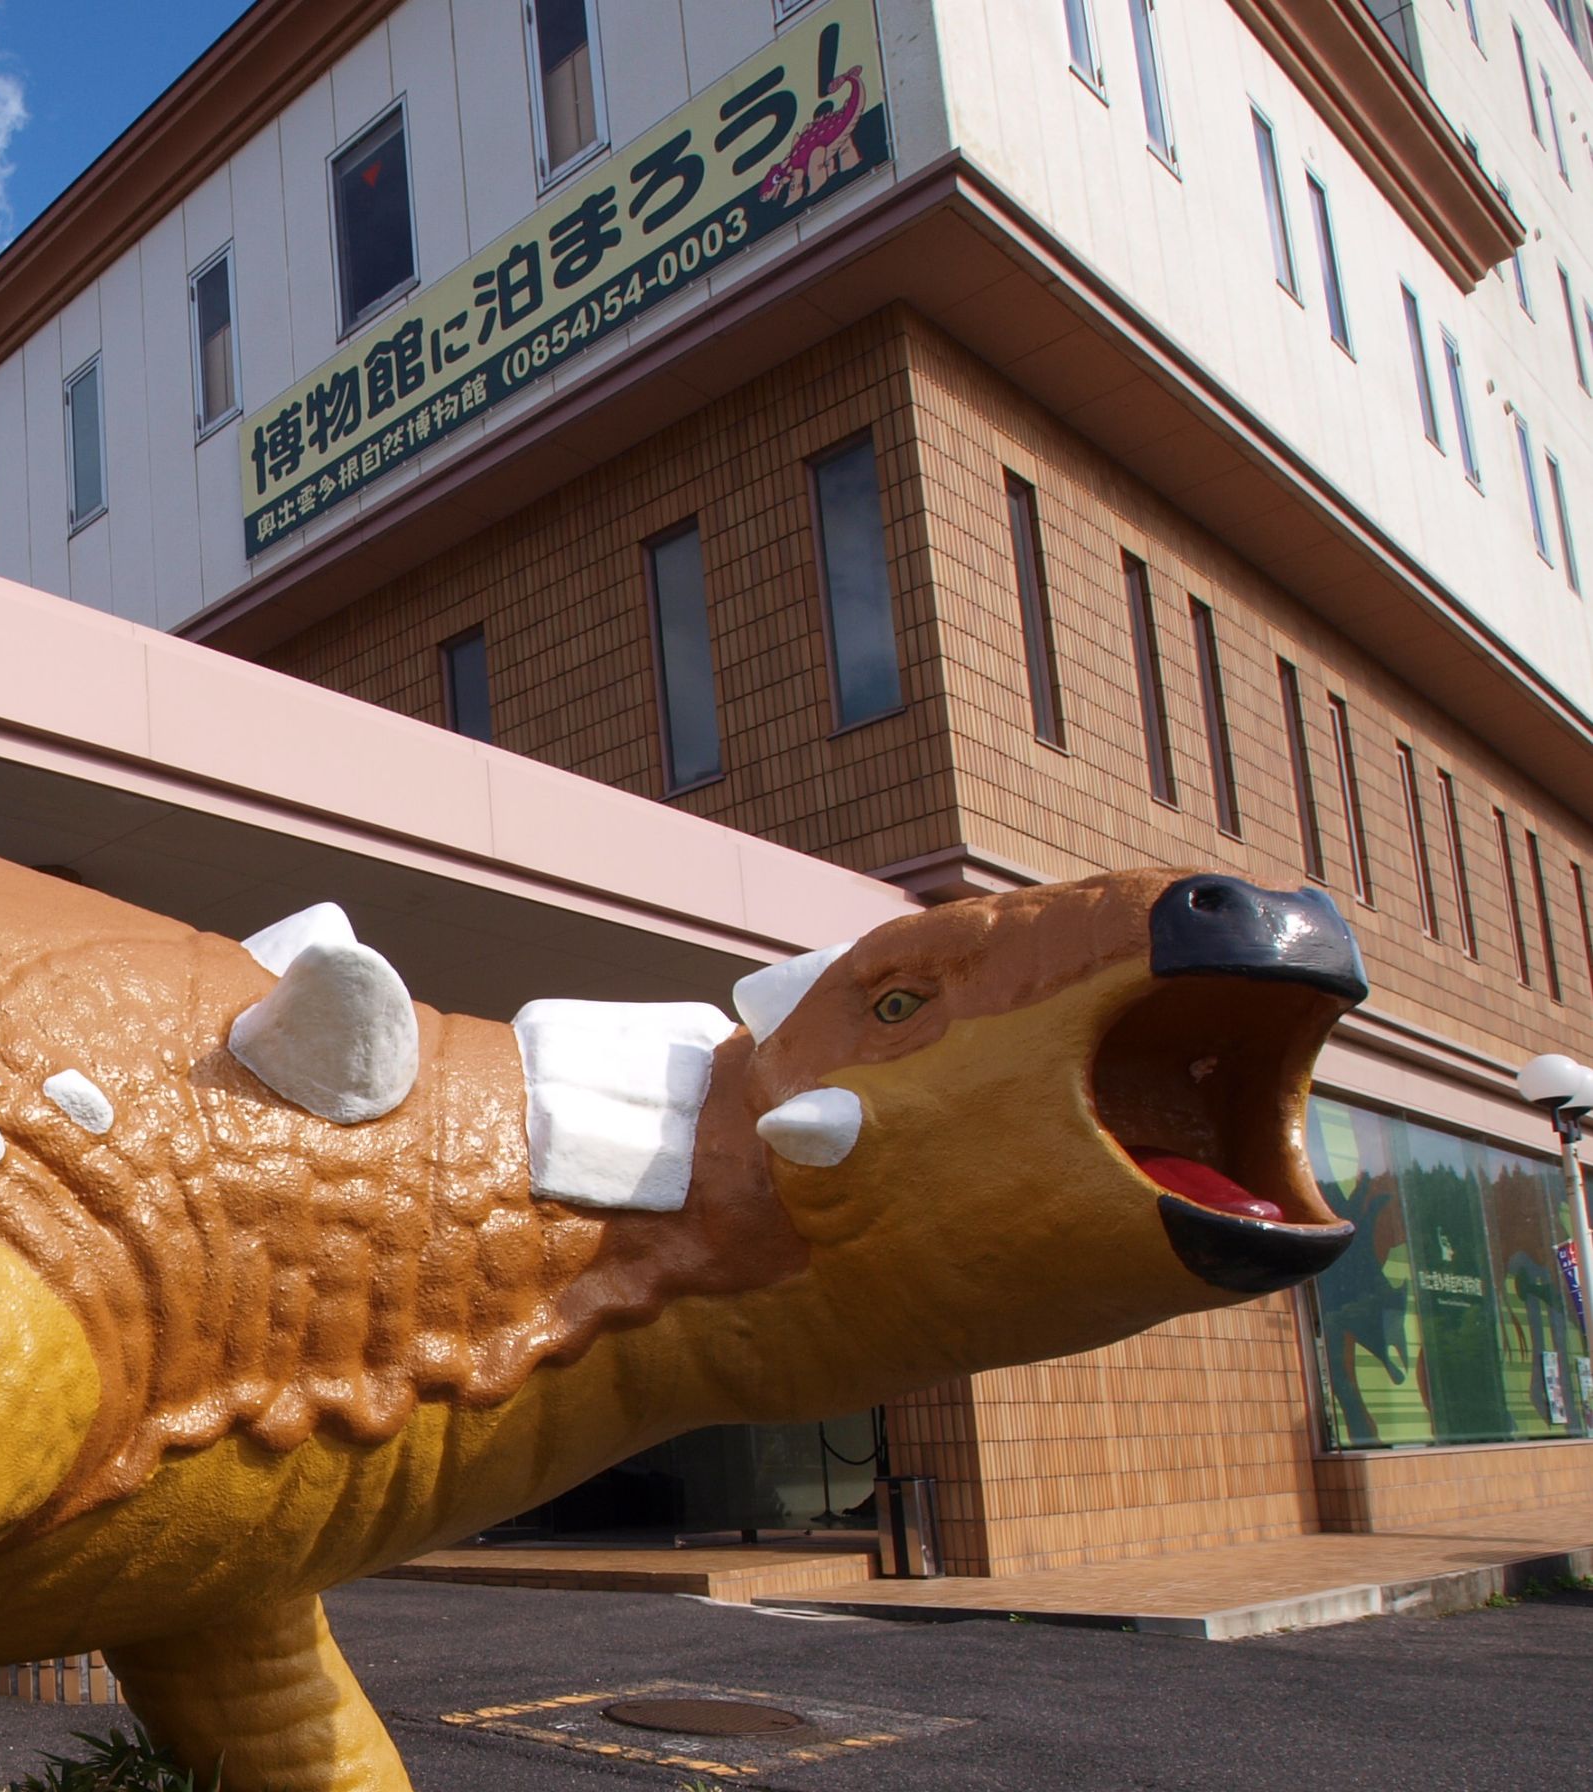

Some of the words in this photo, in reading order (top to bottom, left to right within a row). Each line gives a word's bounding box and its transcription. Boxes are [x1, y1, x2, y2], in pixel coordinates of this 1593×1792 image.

[256, 372, 488, 543] 奥出雲多根自然博物館
[501, 206, 749, 388] (0854)54-0003
